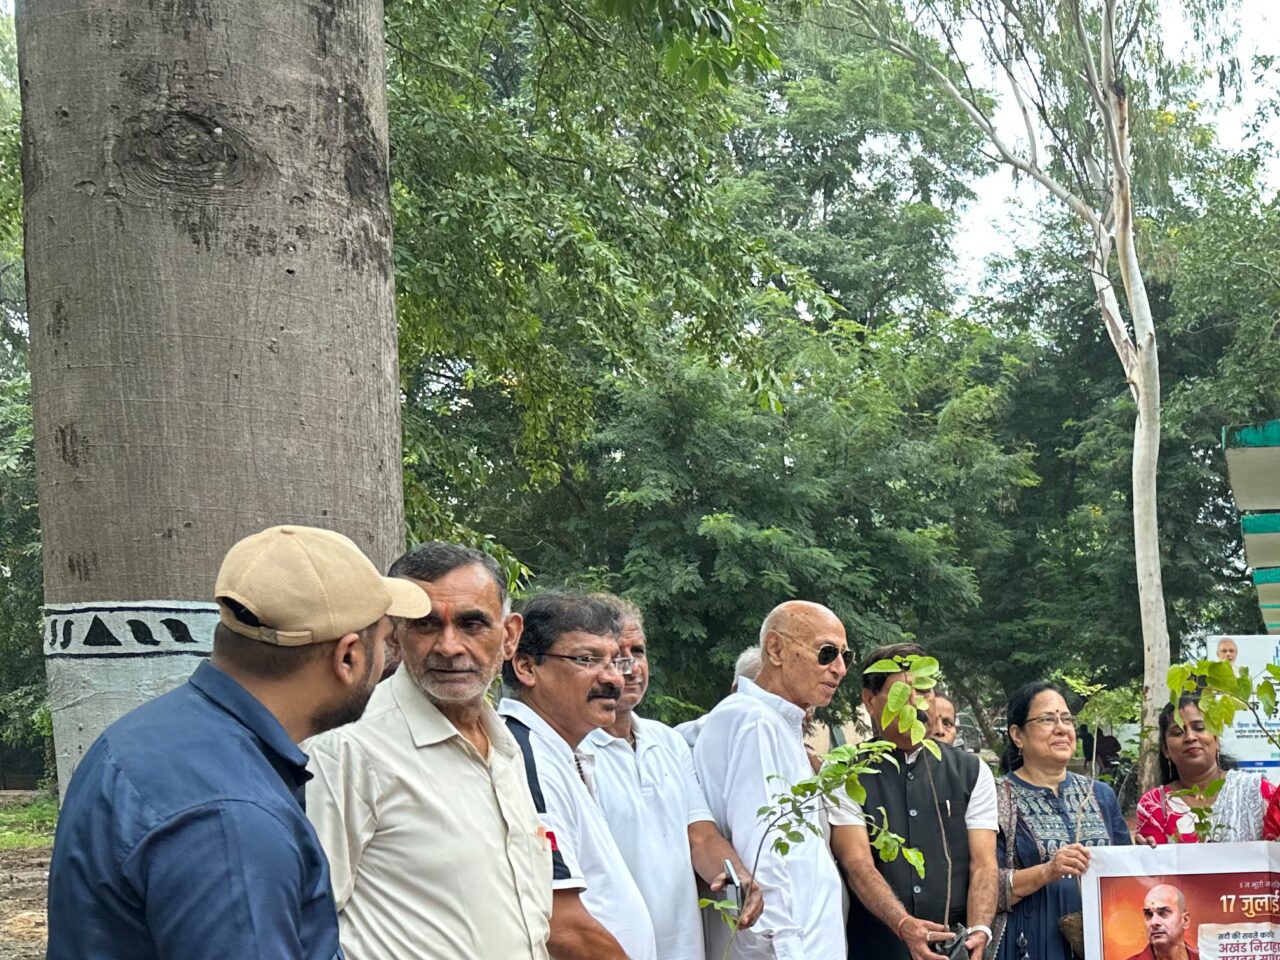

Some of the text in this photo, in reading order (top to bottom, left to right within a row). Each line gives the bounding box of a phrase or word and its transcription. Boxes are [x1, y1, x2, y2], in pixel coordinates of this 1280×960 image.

[1220, 895, 1236, 913] 17
[1239, 890, 1280, 918] जुलाई
[1219, 940, 1247, 953] अखंड
